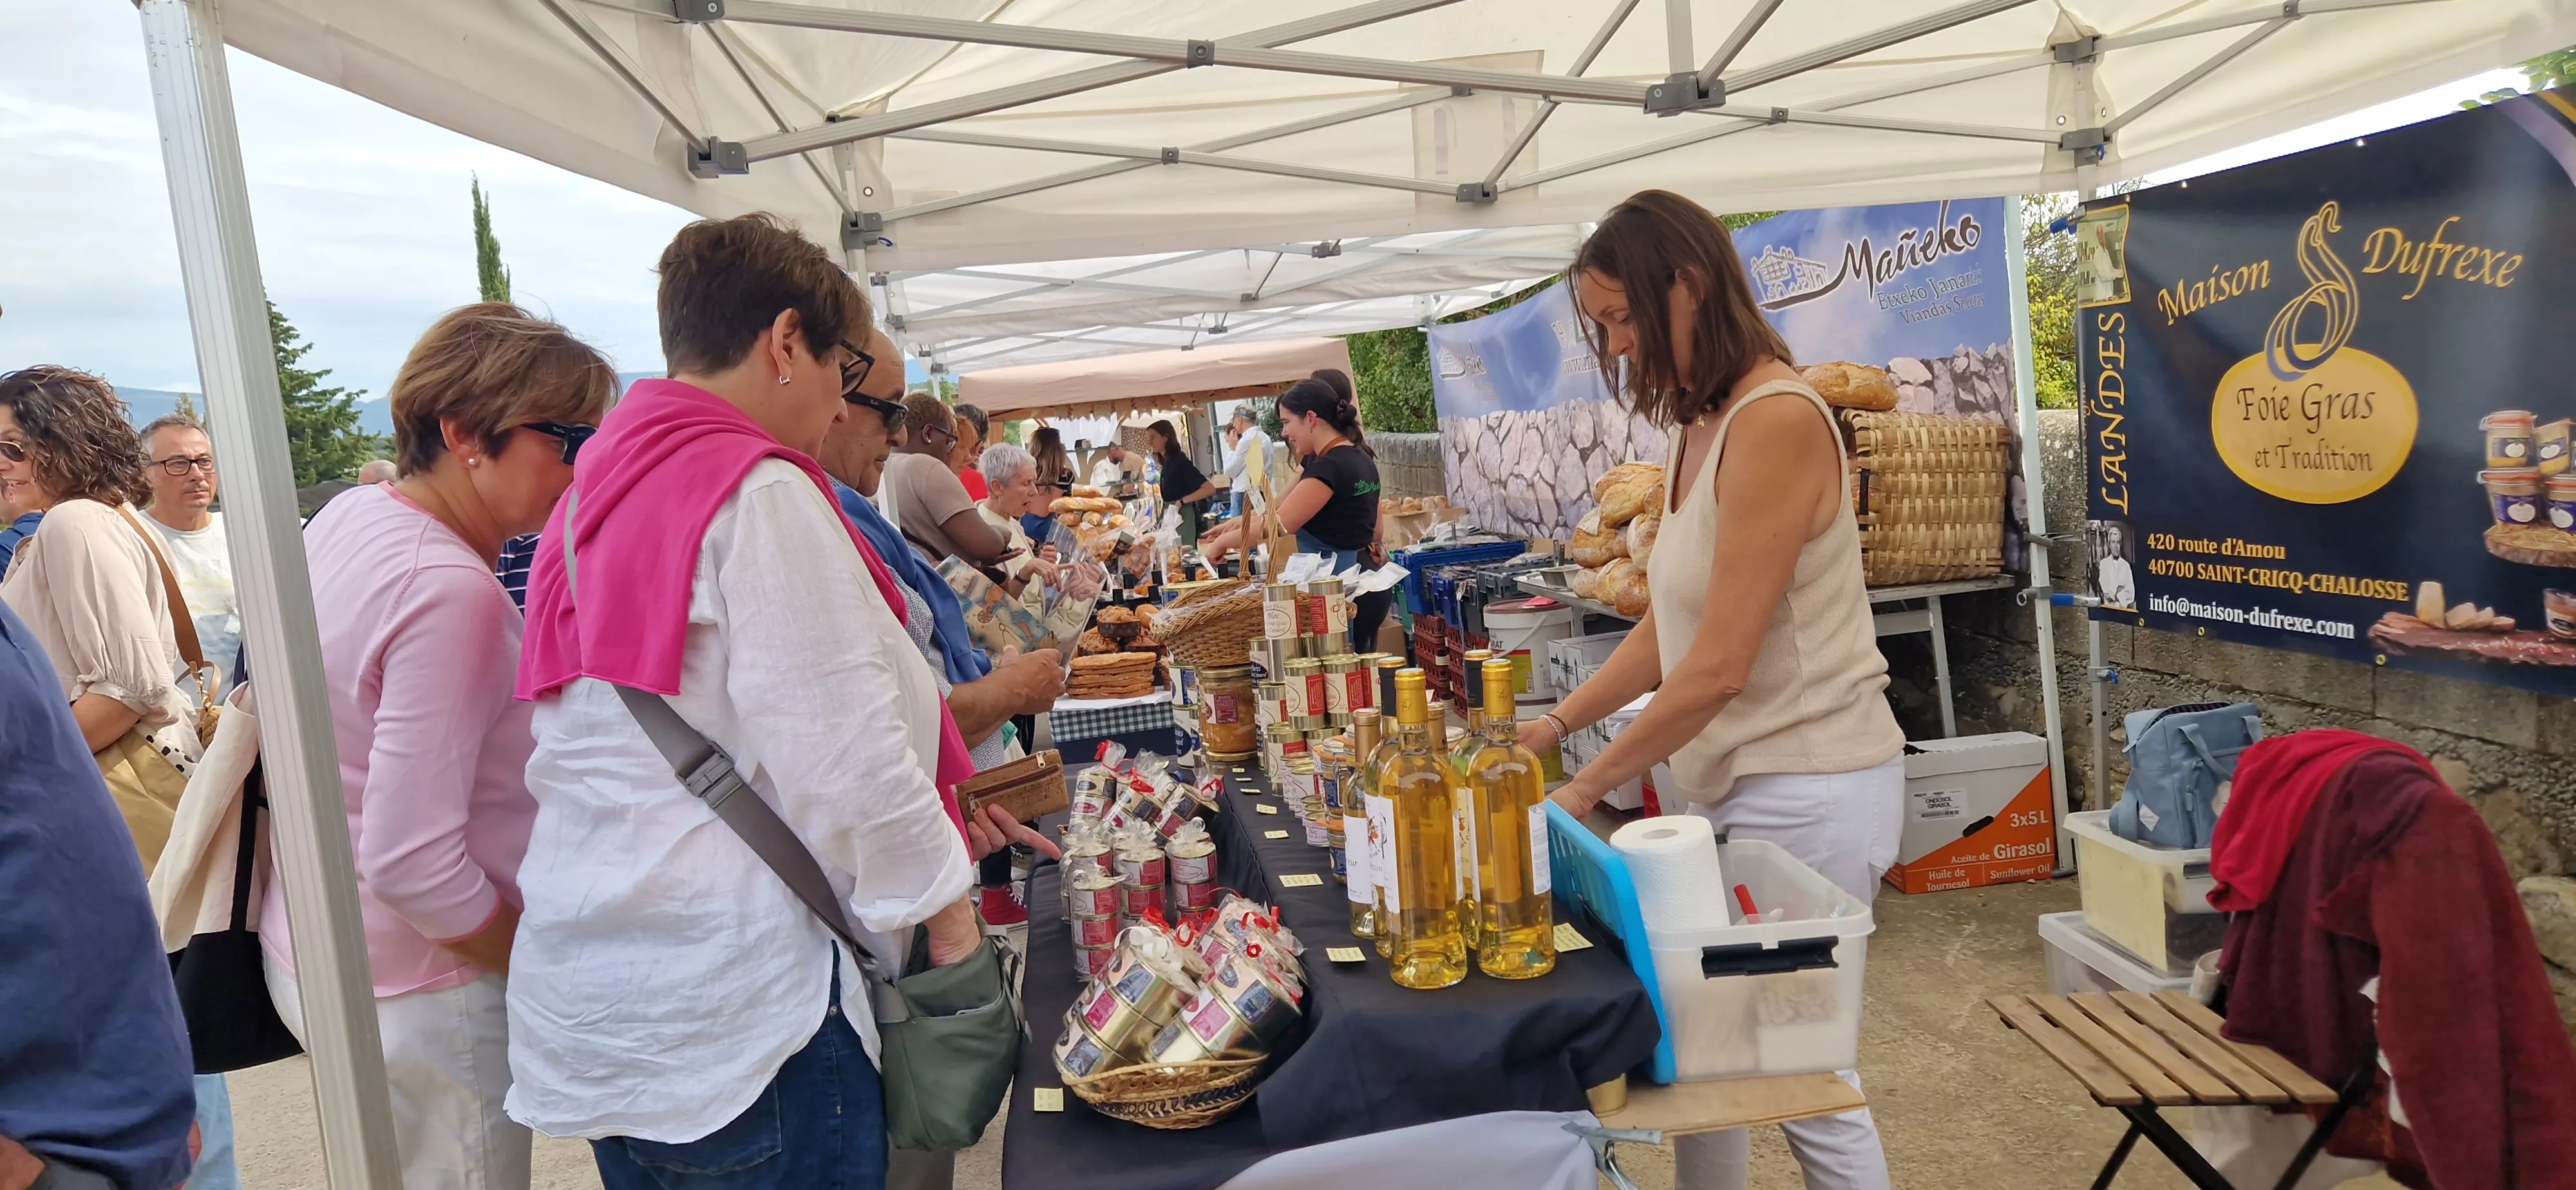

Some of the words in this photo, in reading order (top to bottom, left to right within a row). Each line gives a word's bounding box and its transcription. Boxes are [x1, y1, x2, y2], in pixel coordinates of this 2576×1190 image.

[1829, 199, 1981, 300] Mañeko
[1877, 285, 1927, 310] Etxeko
[1927, 262, 1984, 299] Janariak
[2157, 259, 2271, 326] Maison
[2362, 216, 2524, 301] Dufrexe
[1899, 299, 1953, 325] Viandas
[2091, 312, 2128, 516] LANDES
[2237, 385, 2291, 421] Foie
[2301, 382, 2376, 435] Gras
[2255, 448, 2271, 469] et
[2275, 437, 2373, 472] Tradition
[2147, 533, 2175, 551] 420
[2178, 538, 2218, 556] route
[2221, 537, 2286, 560] d'Amou
[2148, 559, 2194, 579] 40700
[2197, 563, 2410, 602] SAINT-CRICQ-CHALOSSE
[2149, 592, 2355, 640] info@maison-dufrexe.com
[2010, 811, 2038, 828] 3x5
[2040, 809, 2049, 824] L
[1951, 855, 1977, 864] Aceite
[1979, 852, 1991, 862] de
[1993, 838, 2051, 860] Girasol
[1926, 878, 1969, 892] Tournesol
[1929, 870, 1953, 880] Huile
[1954, 867, 1965, 878] de
[1990, 867, 2035, 880] Sunflower
[2038, 864, 2050, 873] Oil
